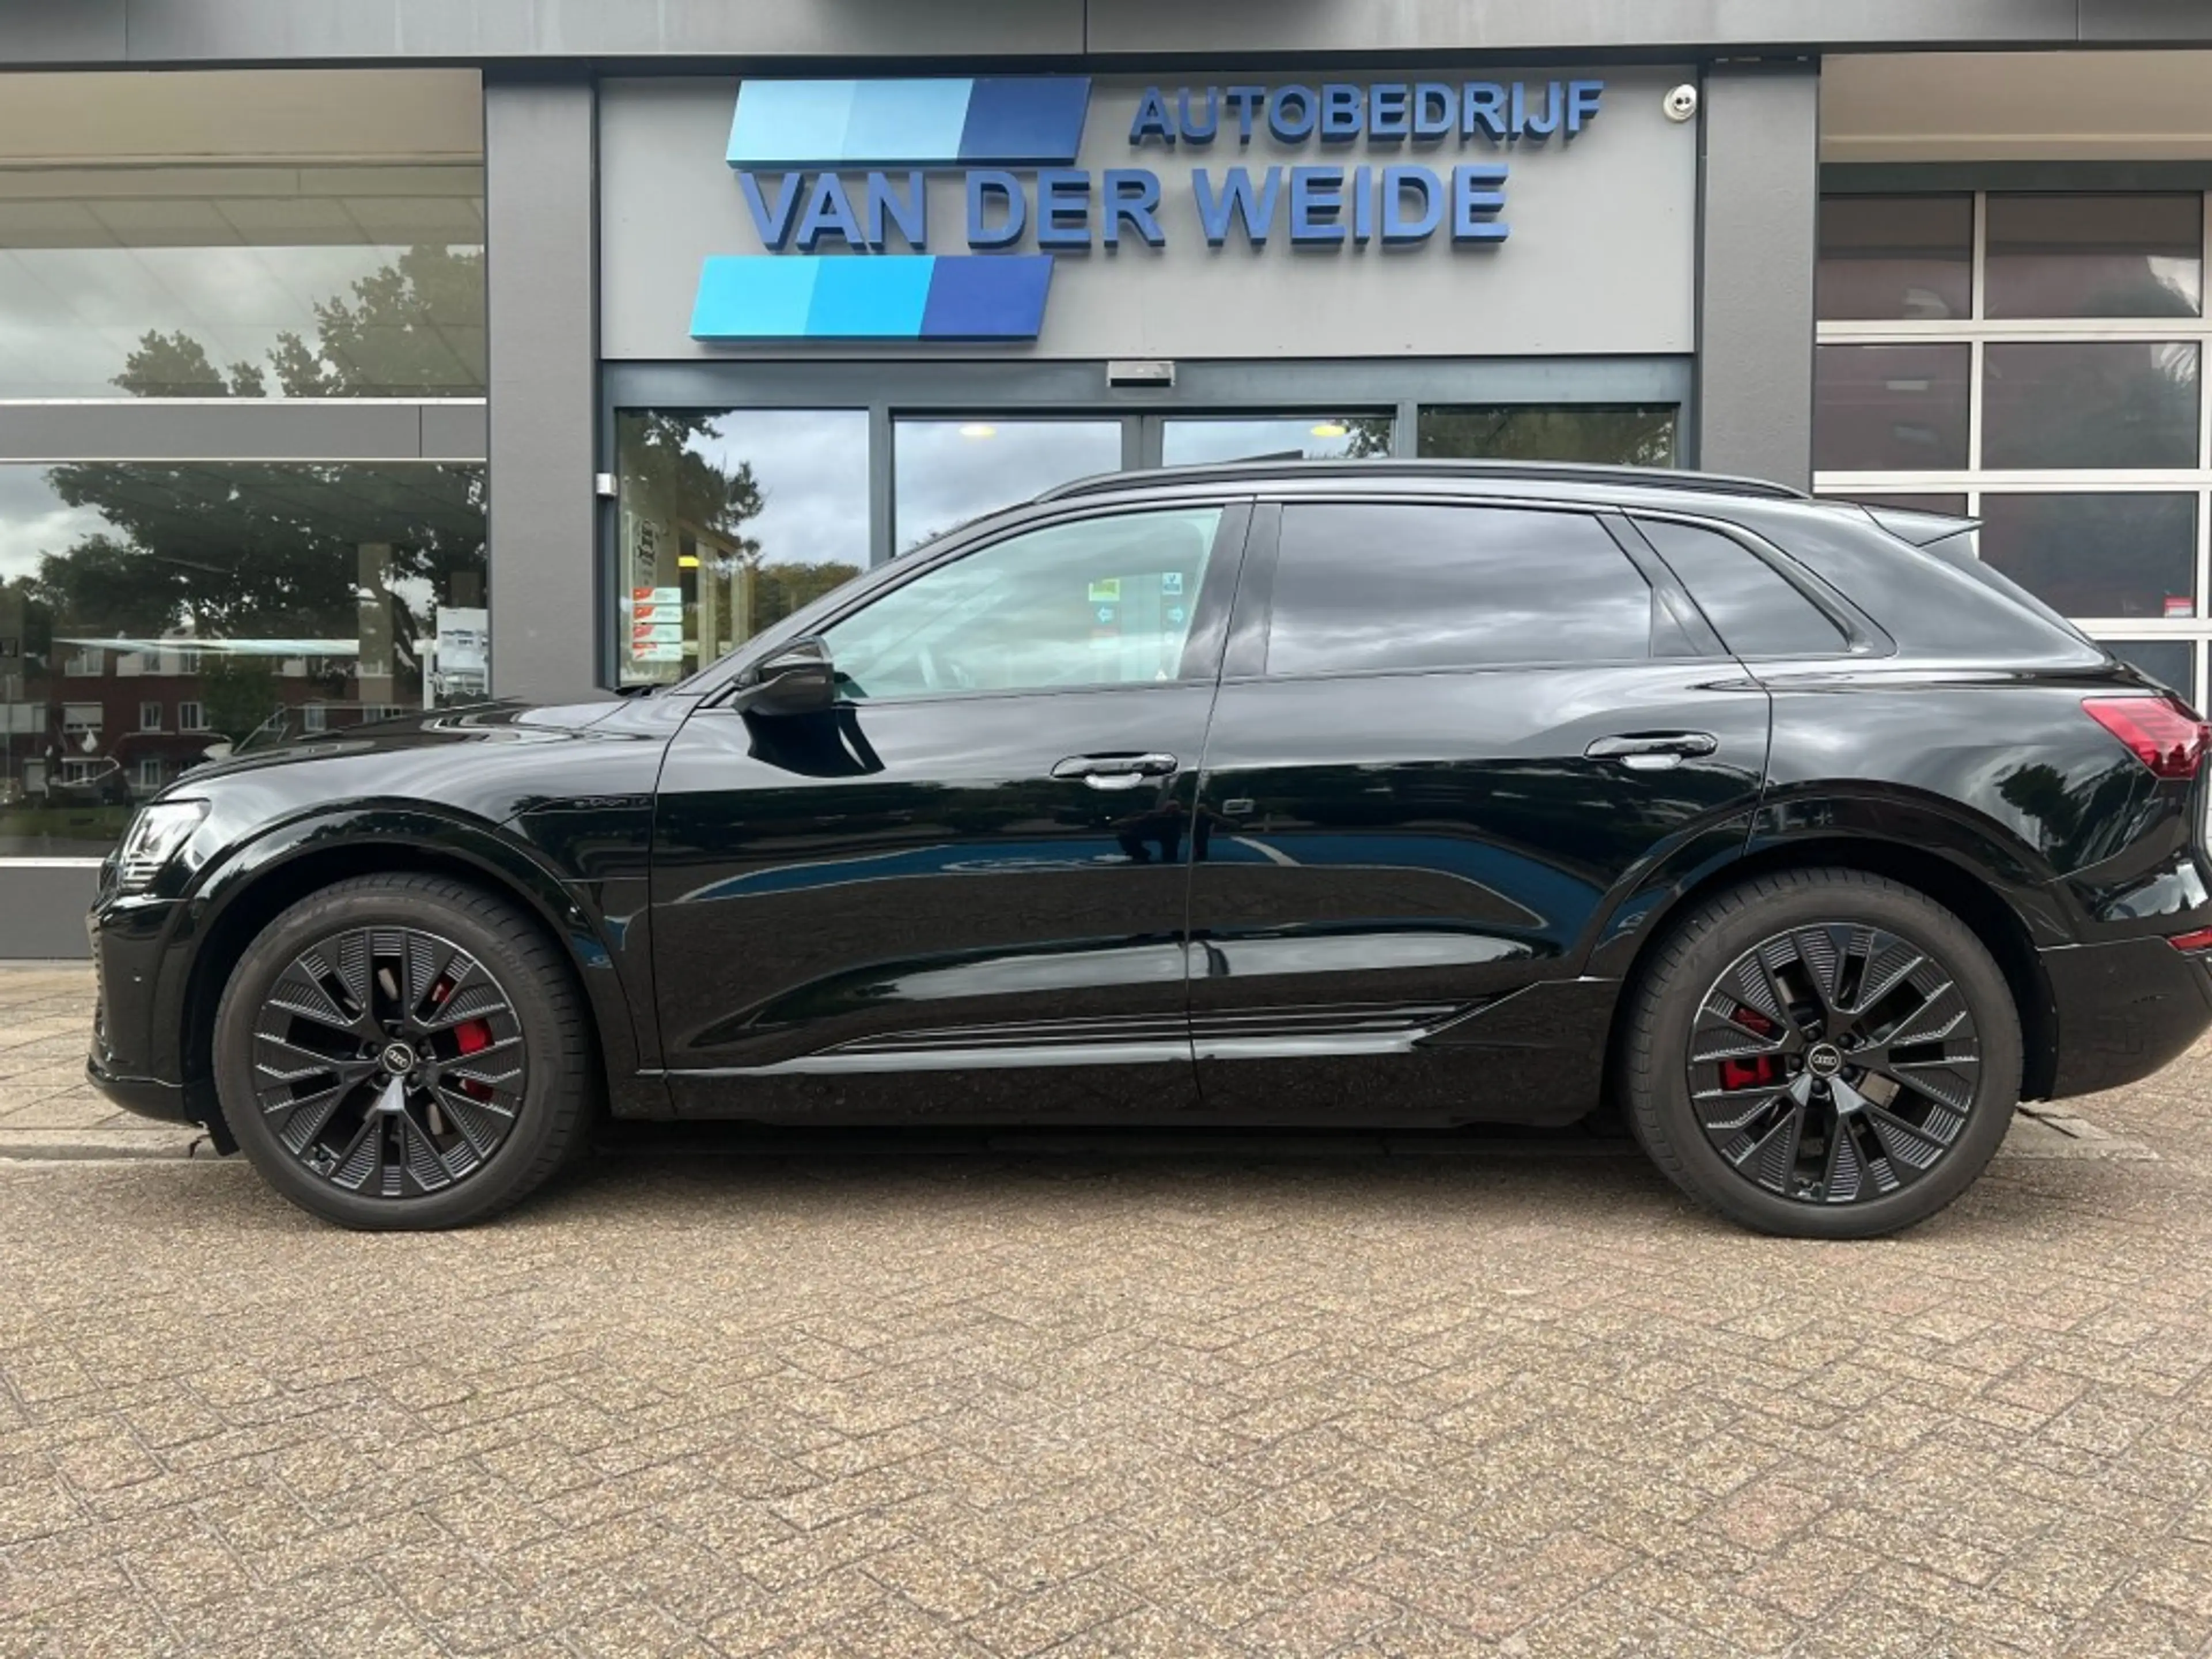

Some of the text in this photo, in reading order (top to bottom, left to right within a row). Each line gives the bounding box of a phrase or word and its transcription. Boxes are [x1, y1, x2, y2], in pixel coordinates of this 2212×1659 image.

[1129, 80, 1605, 145] AUTOBEDRIJF
[737, 163, 1511, 252] VAN DER WEIDE
